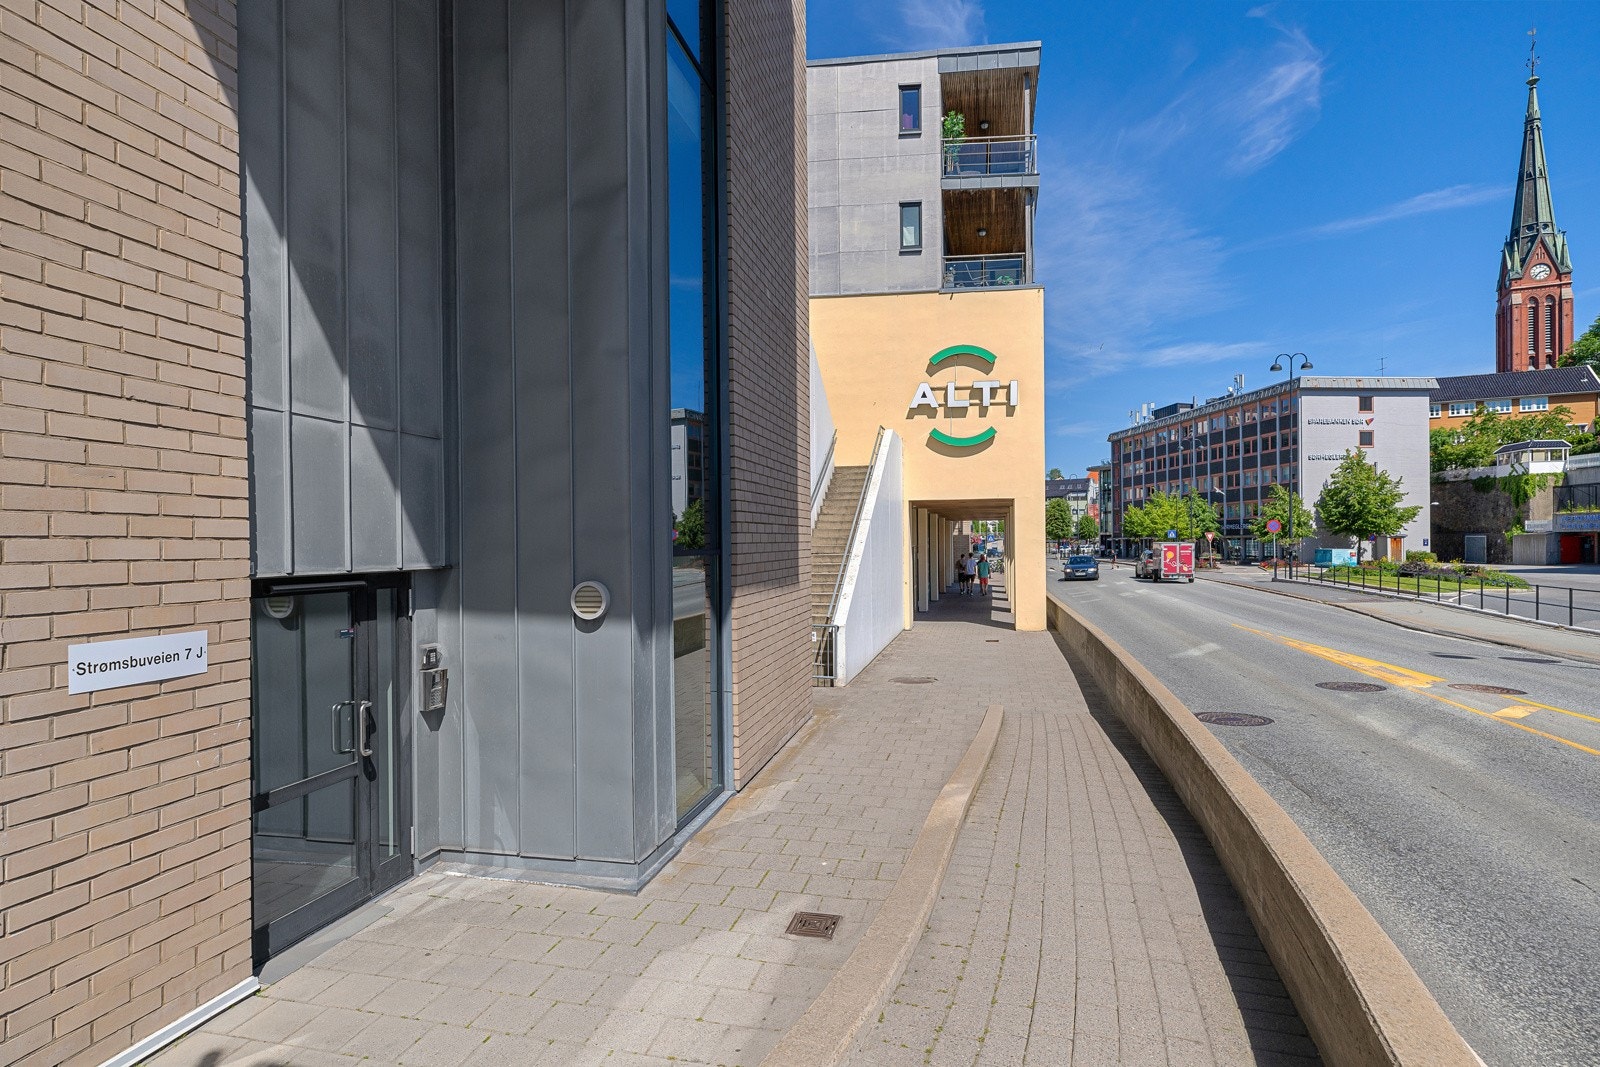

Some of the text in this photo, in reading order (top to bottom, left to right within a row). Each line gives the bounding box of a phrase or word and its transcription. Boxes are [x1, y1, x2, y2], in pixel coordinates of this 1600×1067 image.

[909, 380, 1018, 409] ALTI
[76, 646, 203, 676] Strømsbuveien 7 J
